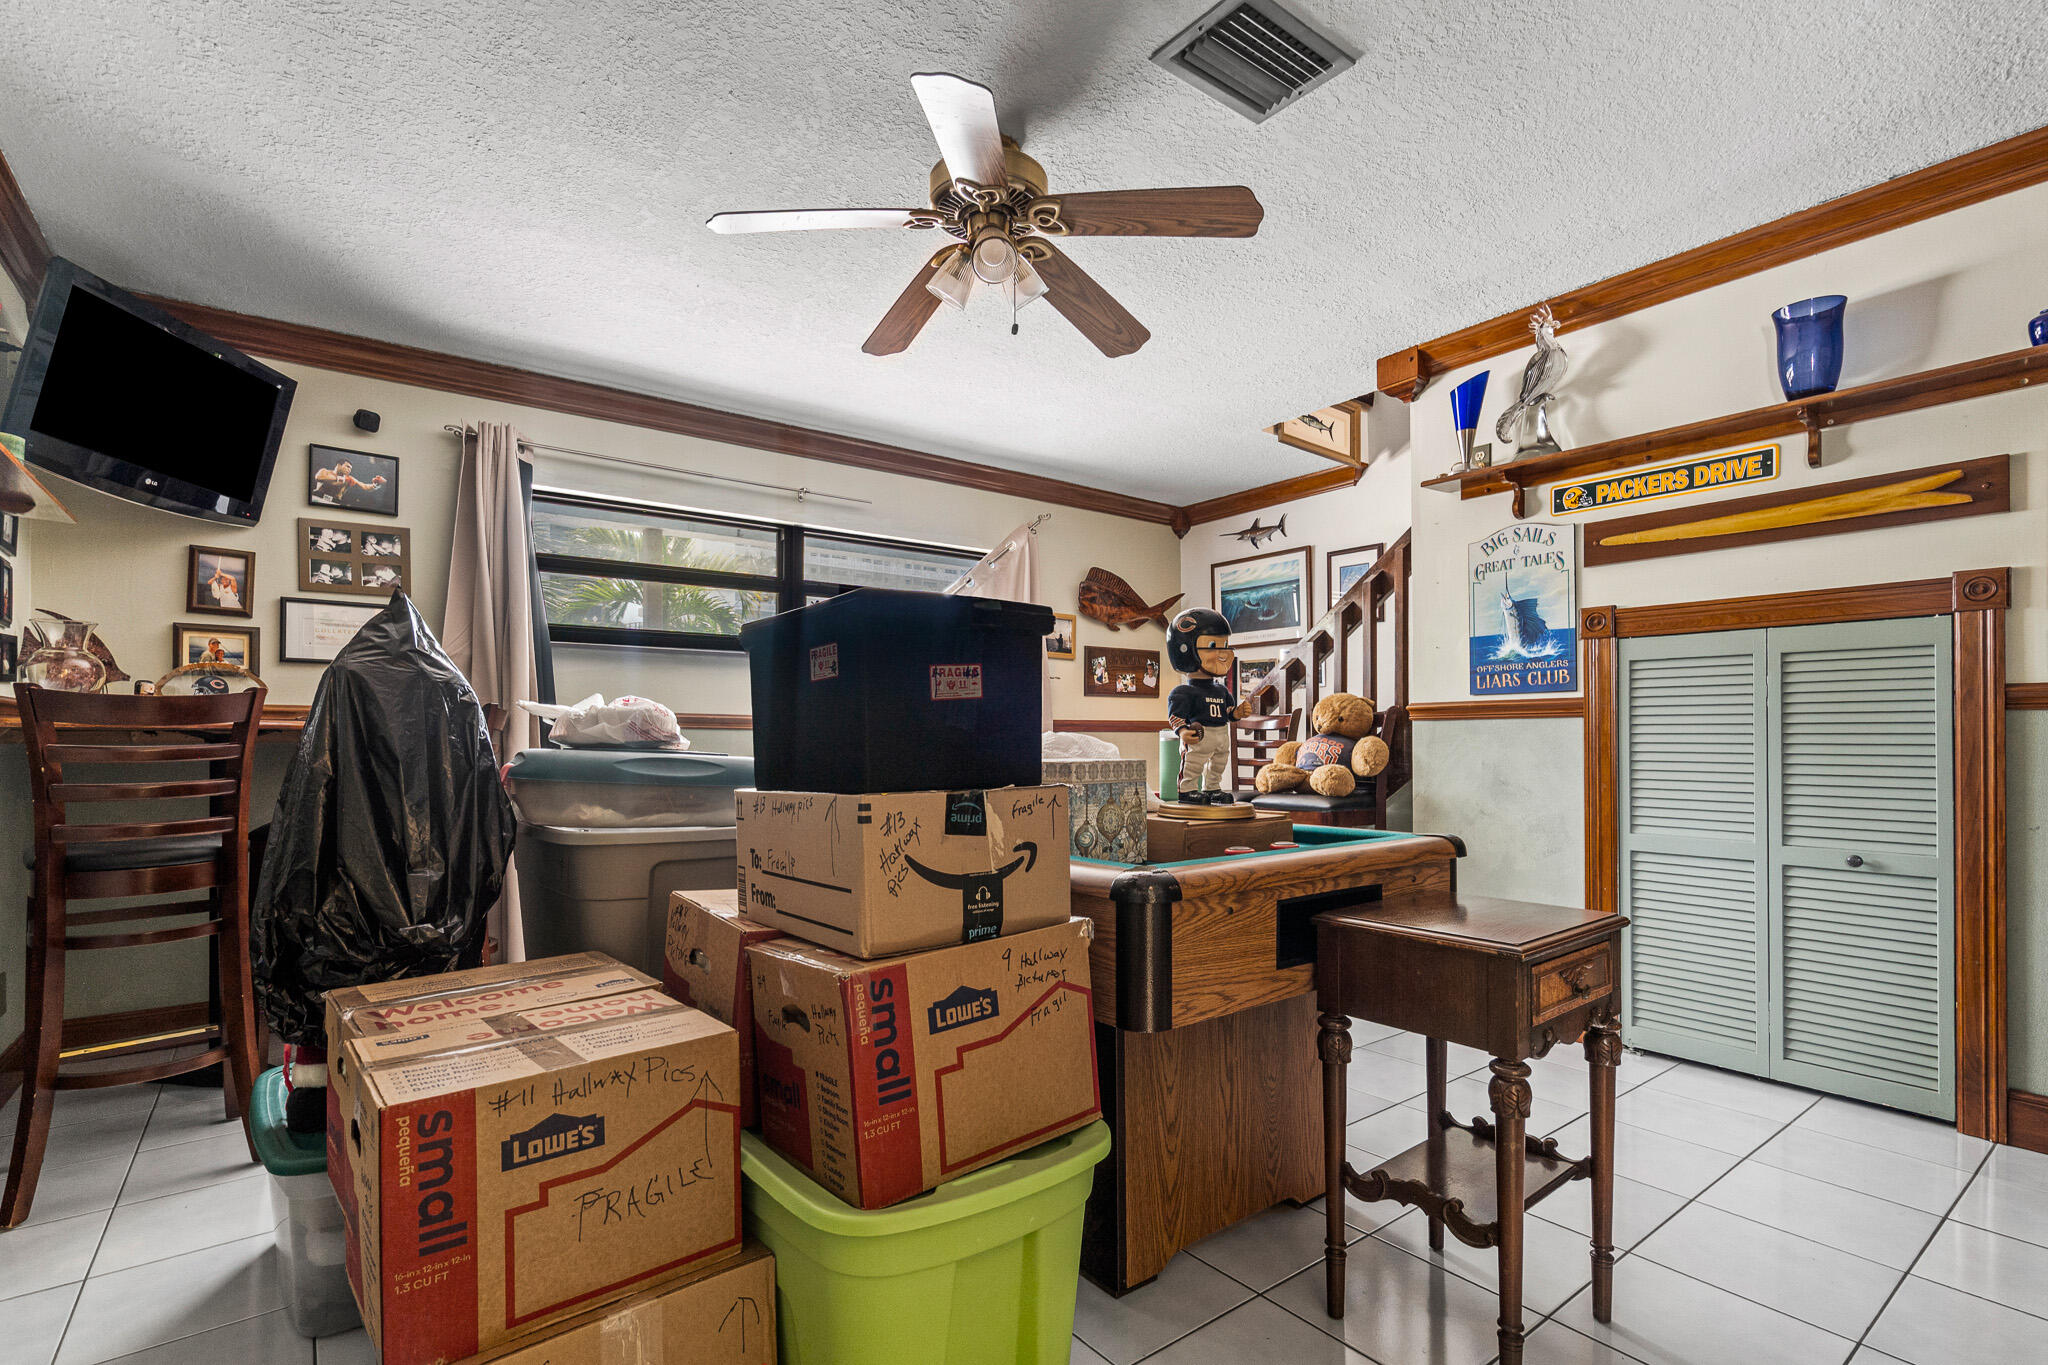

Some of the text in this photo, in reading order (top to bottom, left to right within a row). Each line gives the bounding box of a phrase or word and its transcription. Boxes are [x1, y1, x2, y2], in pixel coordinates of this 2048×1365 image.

[1596, 454, 1763, 504] PACKERS DRIVE
[1481, 527, 1557, 557] BIG SAILS
[1474, 551, 1565, 581] GREAT TALES
[1476, 660, 1569, 673] OFFSHORE ANGLERS
[1476, 669, 1570, 689] LIARS CLUB
[1210, 704, 1222, 717] 01
[951, 812, 982, 826] prime
[1012, 794, 1045, 818] Fragile
[880, 811, 906, 837] #13
[750, 848, 762, 870] To:
[751, 883, 776, 909] From:
[969, 925, 997, 940] prime
[367, 981, 564, 1019] Welcome
[853, 983, 869, 1046] pequeña
[935, 997, 993, 1028] LOWE'S
[374, 1002, 516, 1030] home.
[466, 1001, 667, 1041] Welcome
[869, 977, 912, 1106] small
[488, 1084, 535, 1118] #11
[644, 1056, 696, 1083] Pics
[513, 1125, 598, 1164] LOWE'S
[864, 1121, 901, 1140] 1.3 CU FT
[396, 1116, 415, 1187] pequeña
[418, 1110, 468, 1257] small
[571, 1158, 715, 1242] FRAGILE
[394, 1270, 415, 1282] 16-in
[422, 1262, 443, 1274] 12-in
[451, 1254, 471, 1265] 12-in
[394, 1271, 449, 1295] 1.3 CU FT
